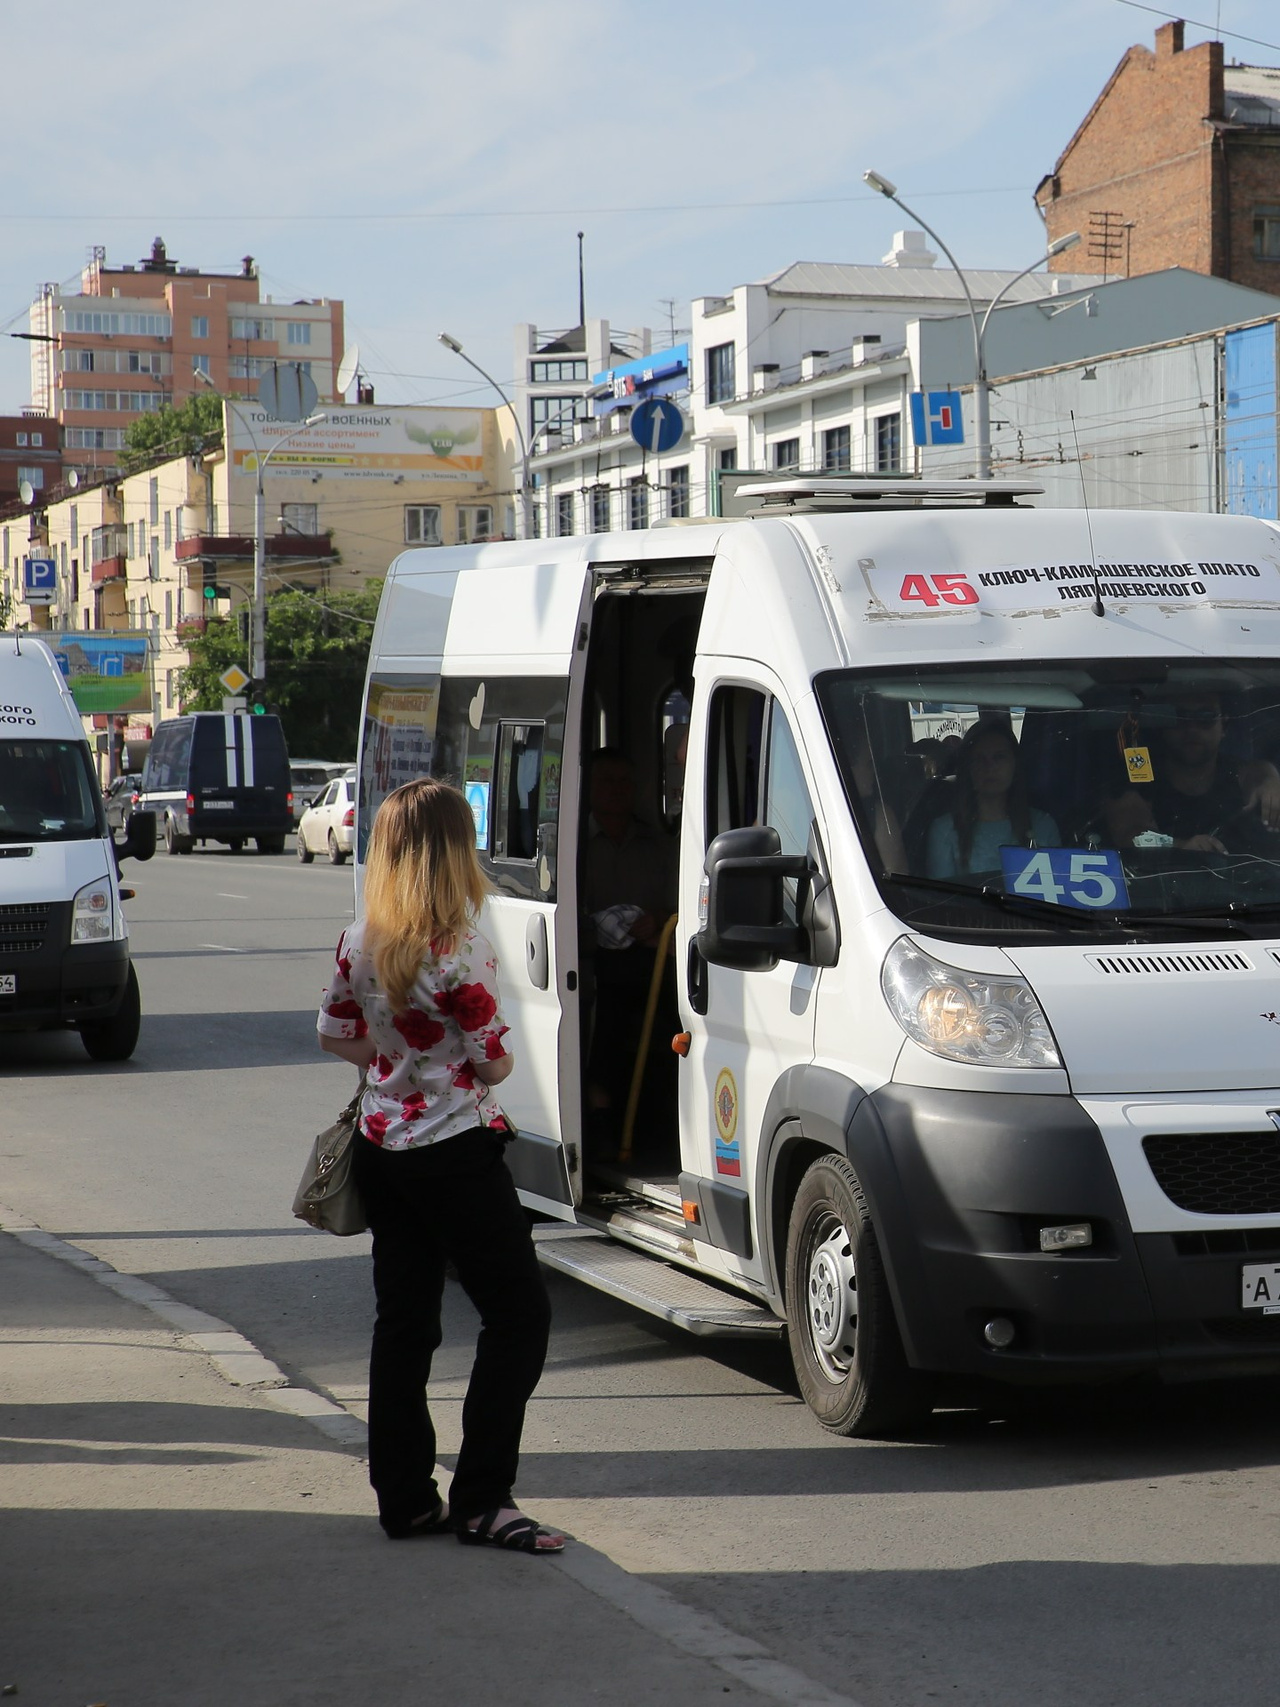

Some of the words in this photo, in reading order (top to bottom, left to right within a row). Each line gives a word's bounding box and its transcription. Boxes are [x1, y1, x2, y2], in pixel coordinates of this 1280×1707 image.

[332, 415, 391, 426] ВОЕННЫХ
[314, 428, 380, 439] ассортимент
[288, 439, 325, 449] Низкие
[328, 441, 356, 451] цены
[32, 562, 49, 586] P
[978, 562, 1197, 587] КЛЮЧ-КАМЫШЕНСКОЕ
[1199, 562, 1260, 577] ПЛАТО
[898, 572, 982, 607] 45
[1057, 580, 1206, 601] ЛЯПИДЕВСКОГО
[0, 705, 33, 715] ого
[1013, 852, 1117, 908] 45
